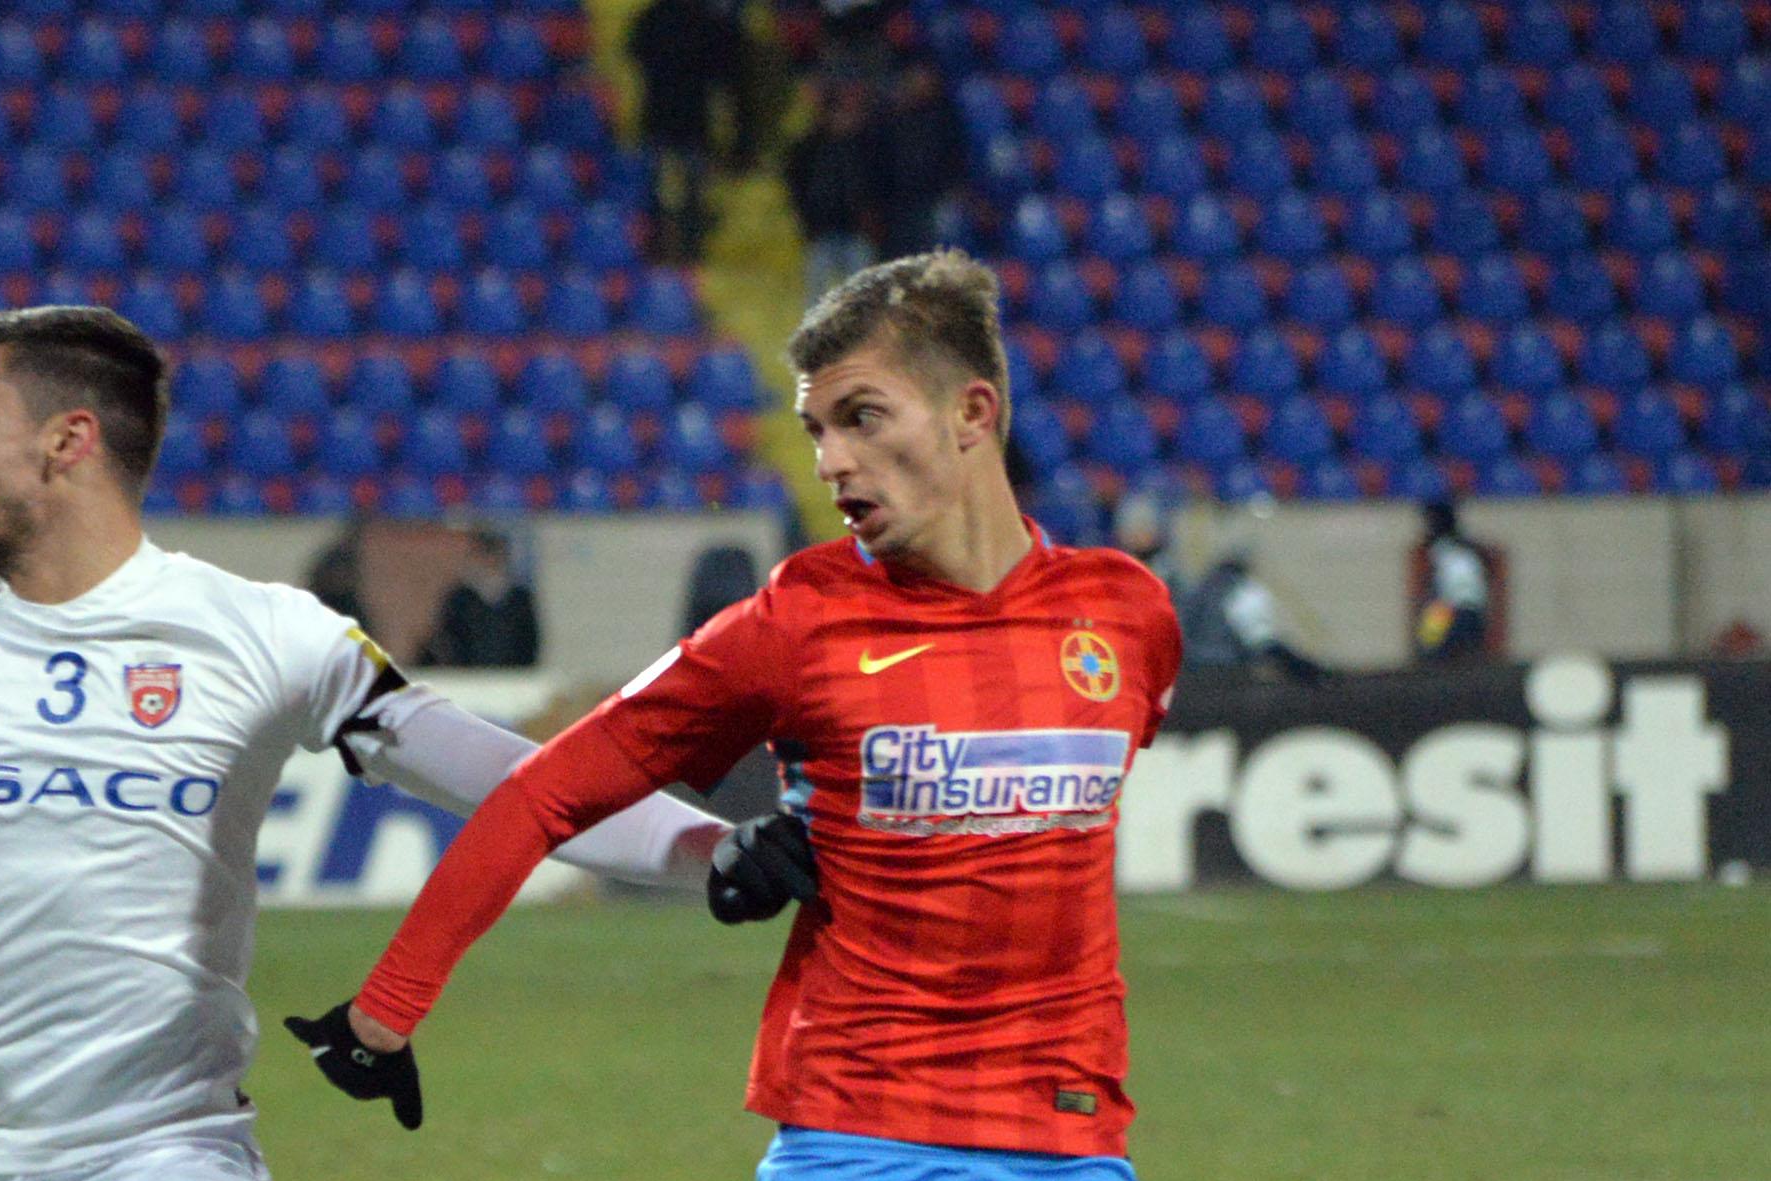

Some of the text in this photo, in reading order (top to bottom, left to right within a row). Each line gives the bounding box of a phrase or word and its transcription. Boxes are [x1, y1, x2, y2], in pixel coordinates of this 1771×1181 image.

[36, 650, 87, 725] 3
[864, 729, 965, 784] City
[1117, 650, 1730, 892] resit
[895, 772, 1122, 811] Insurance
